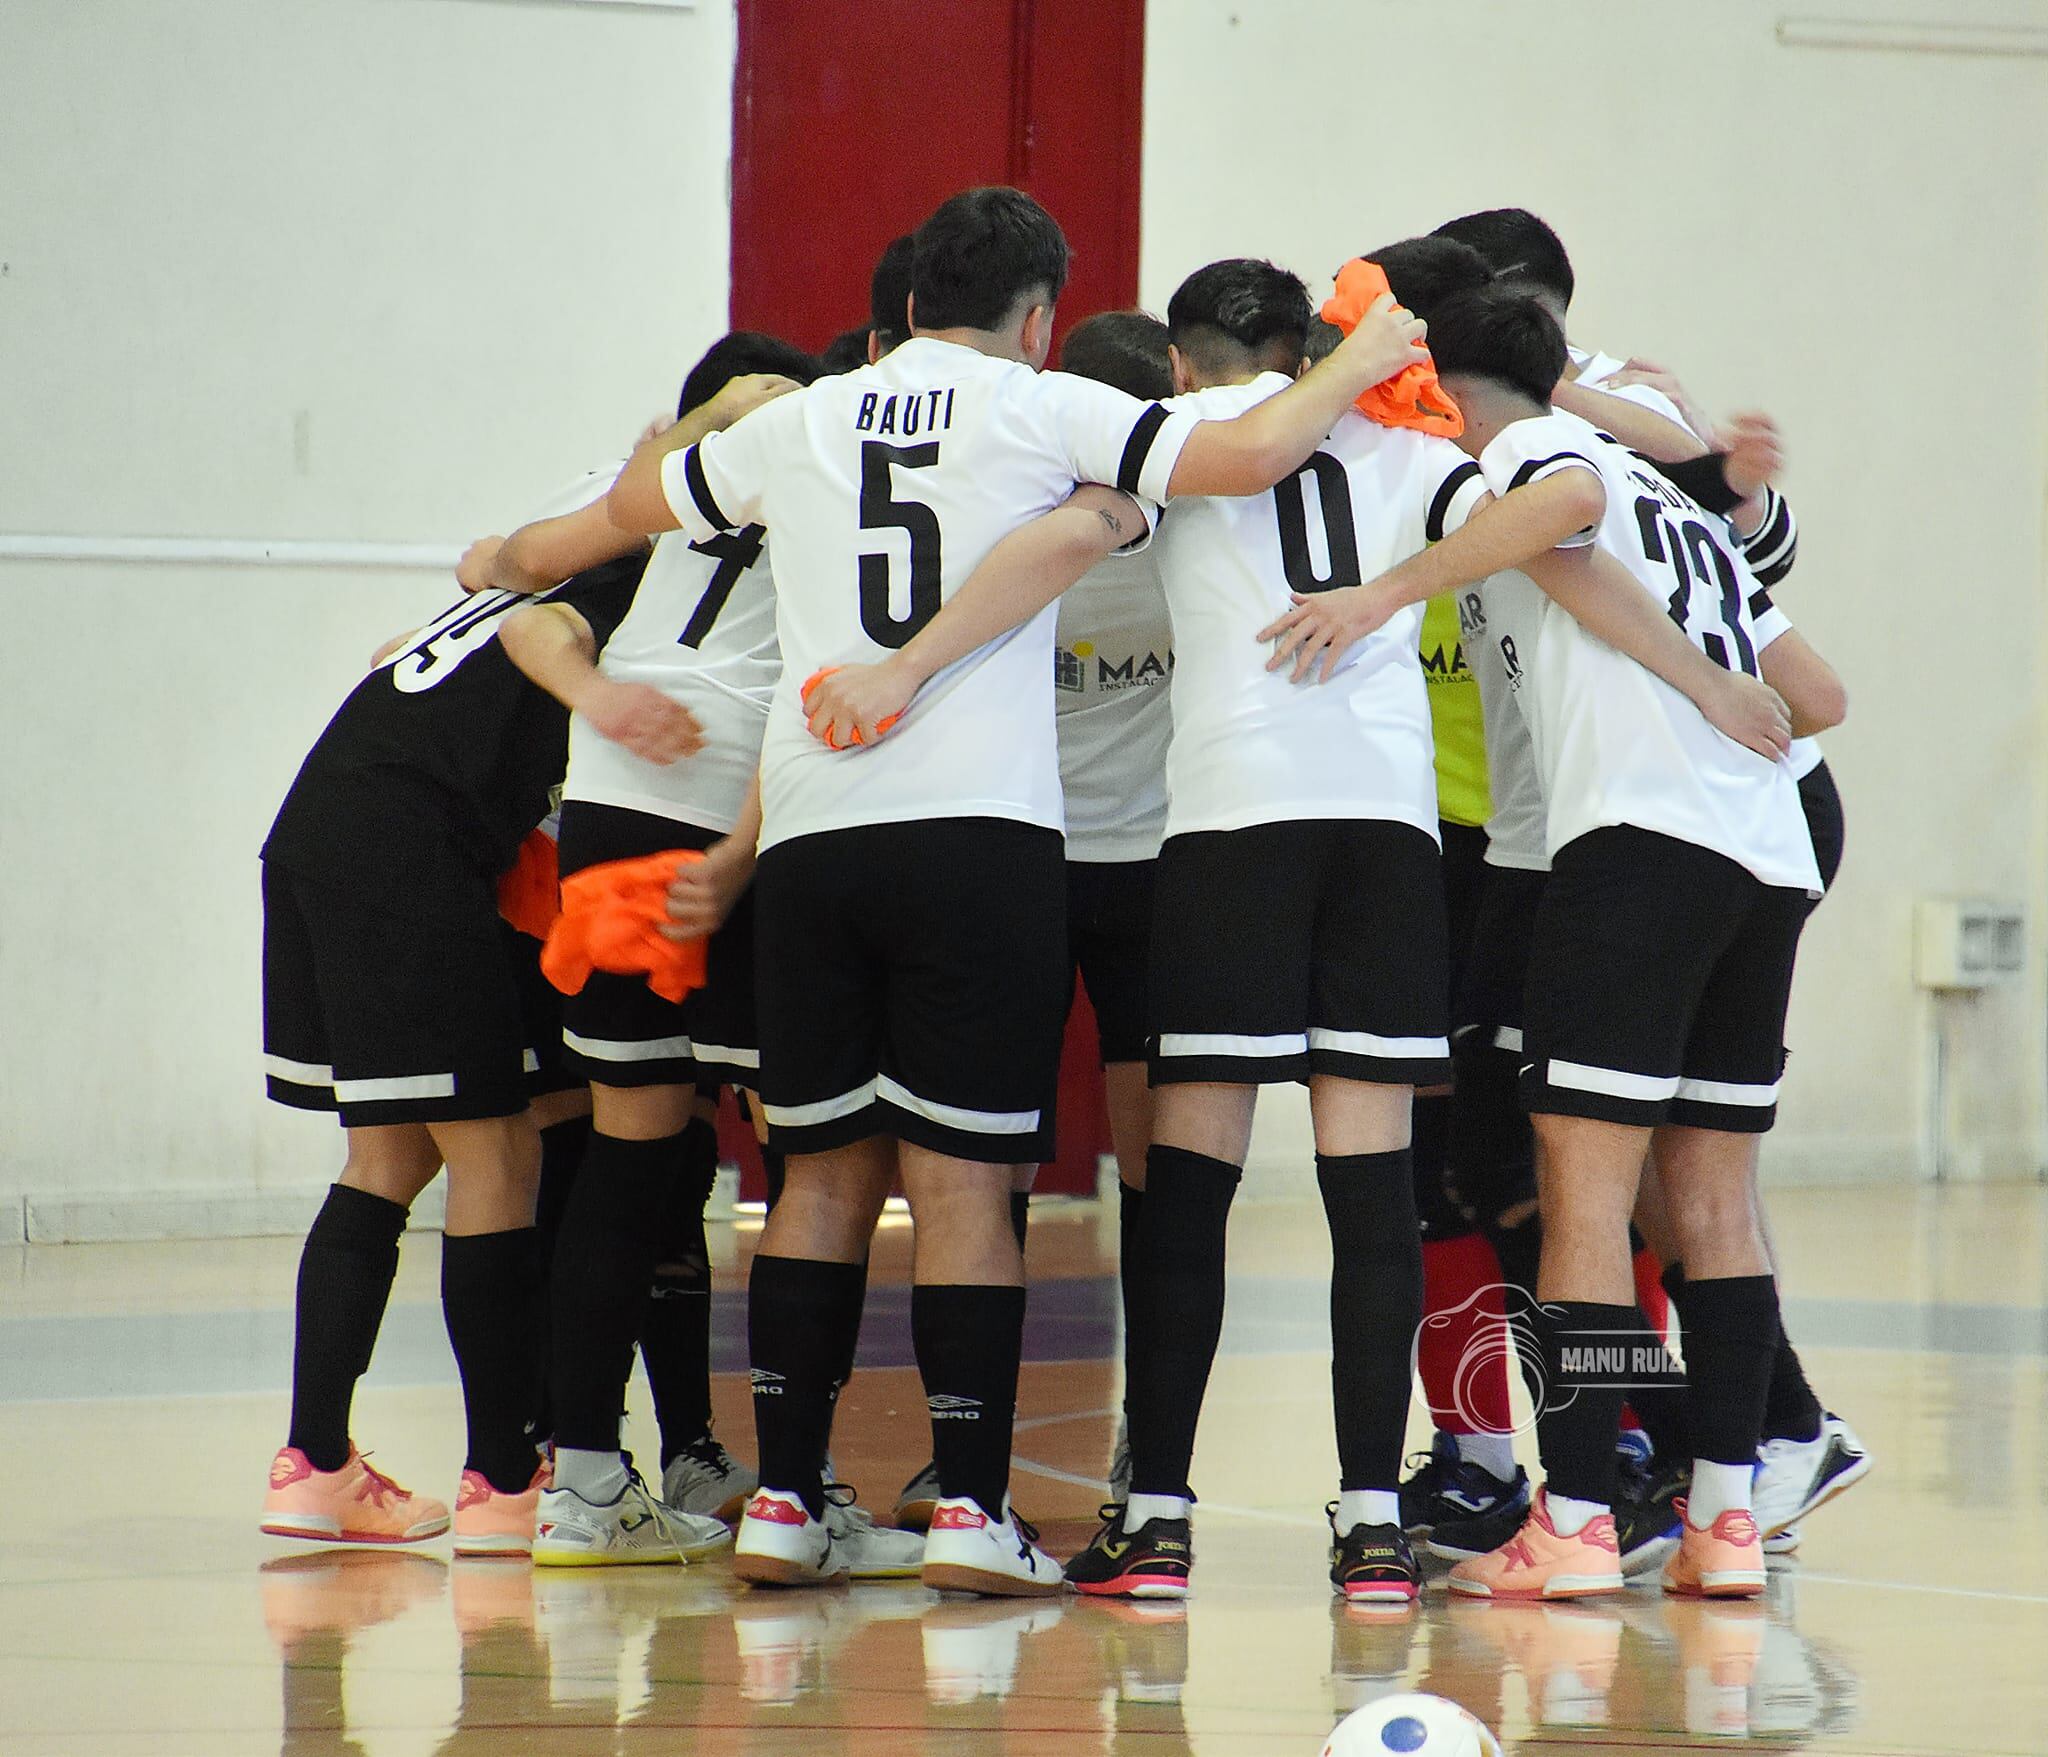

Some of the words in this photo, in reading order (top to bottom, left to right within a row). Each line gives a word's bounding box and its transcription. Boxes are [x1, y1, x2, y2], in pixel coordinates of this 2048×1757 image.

[855, 387, 955, 436] BAUTI
[857, 440, 942, 650] 5
[1634, 495, 1758, 679] 23
